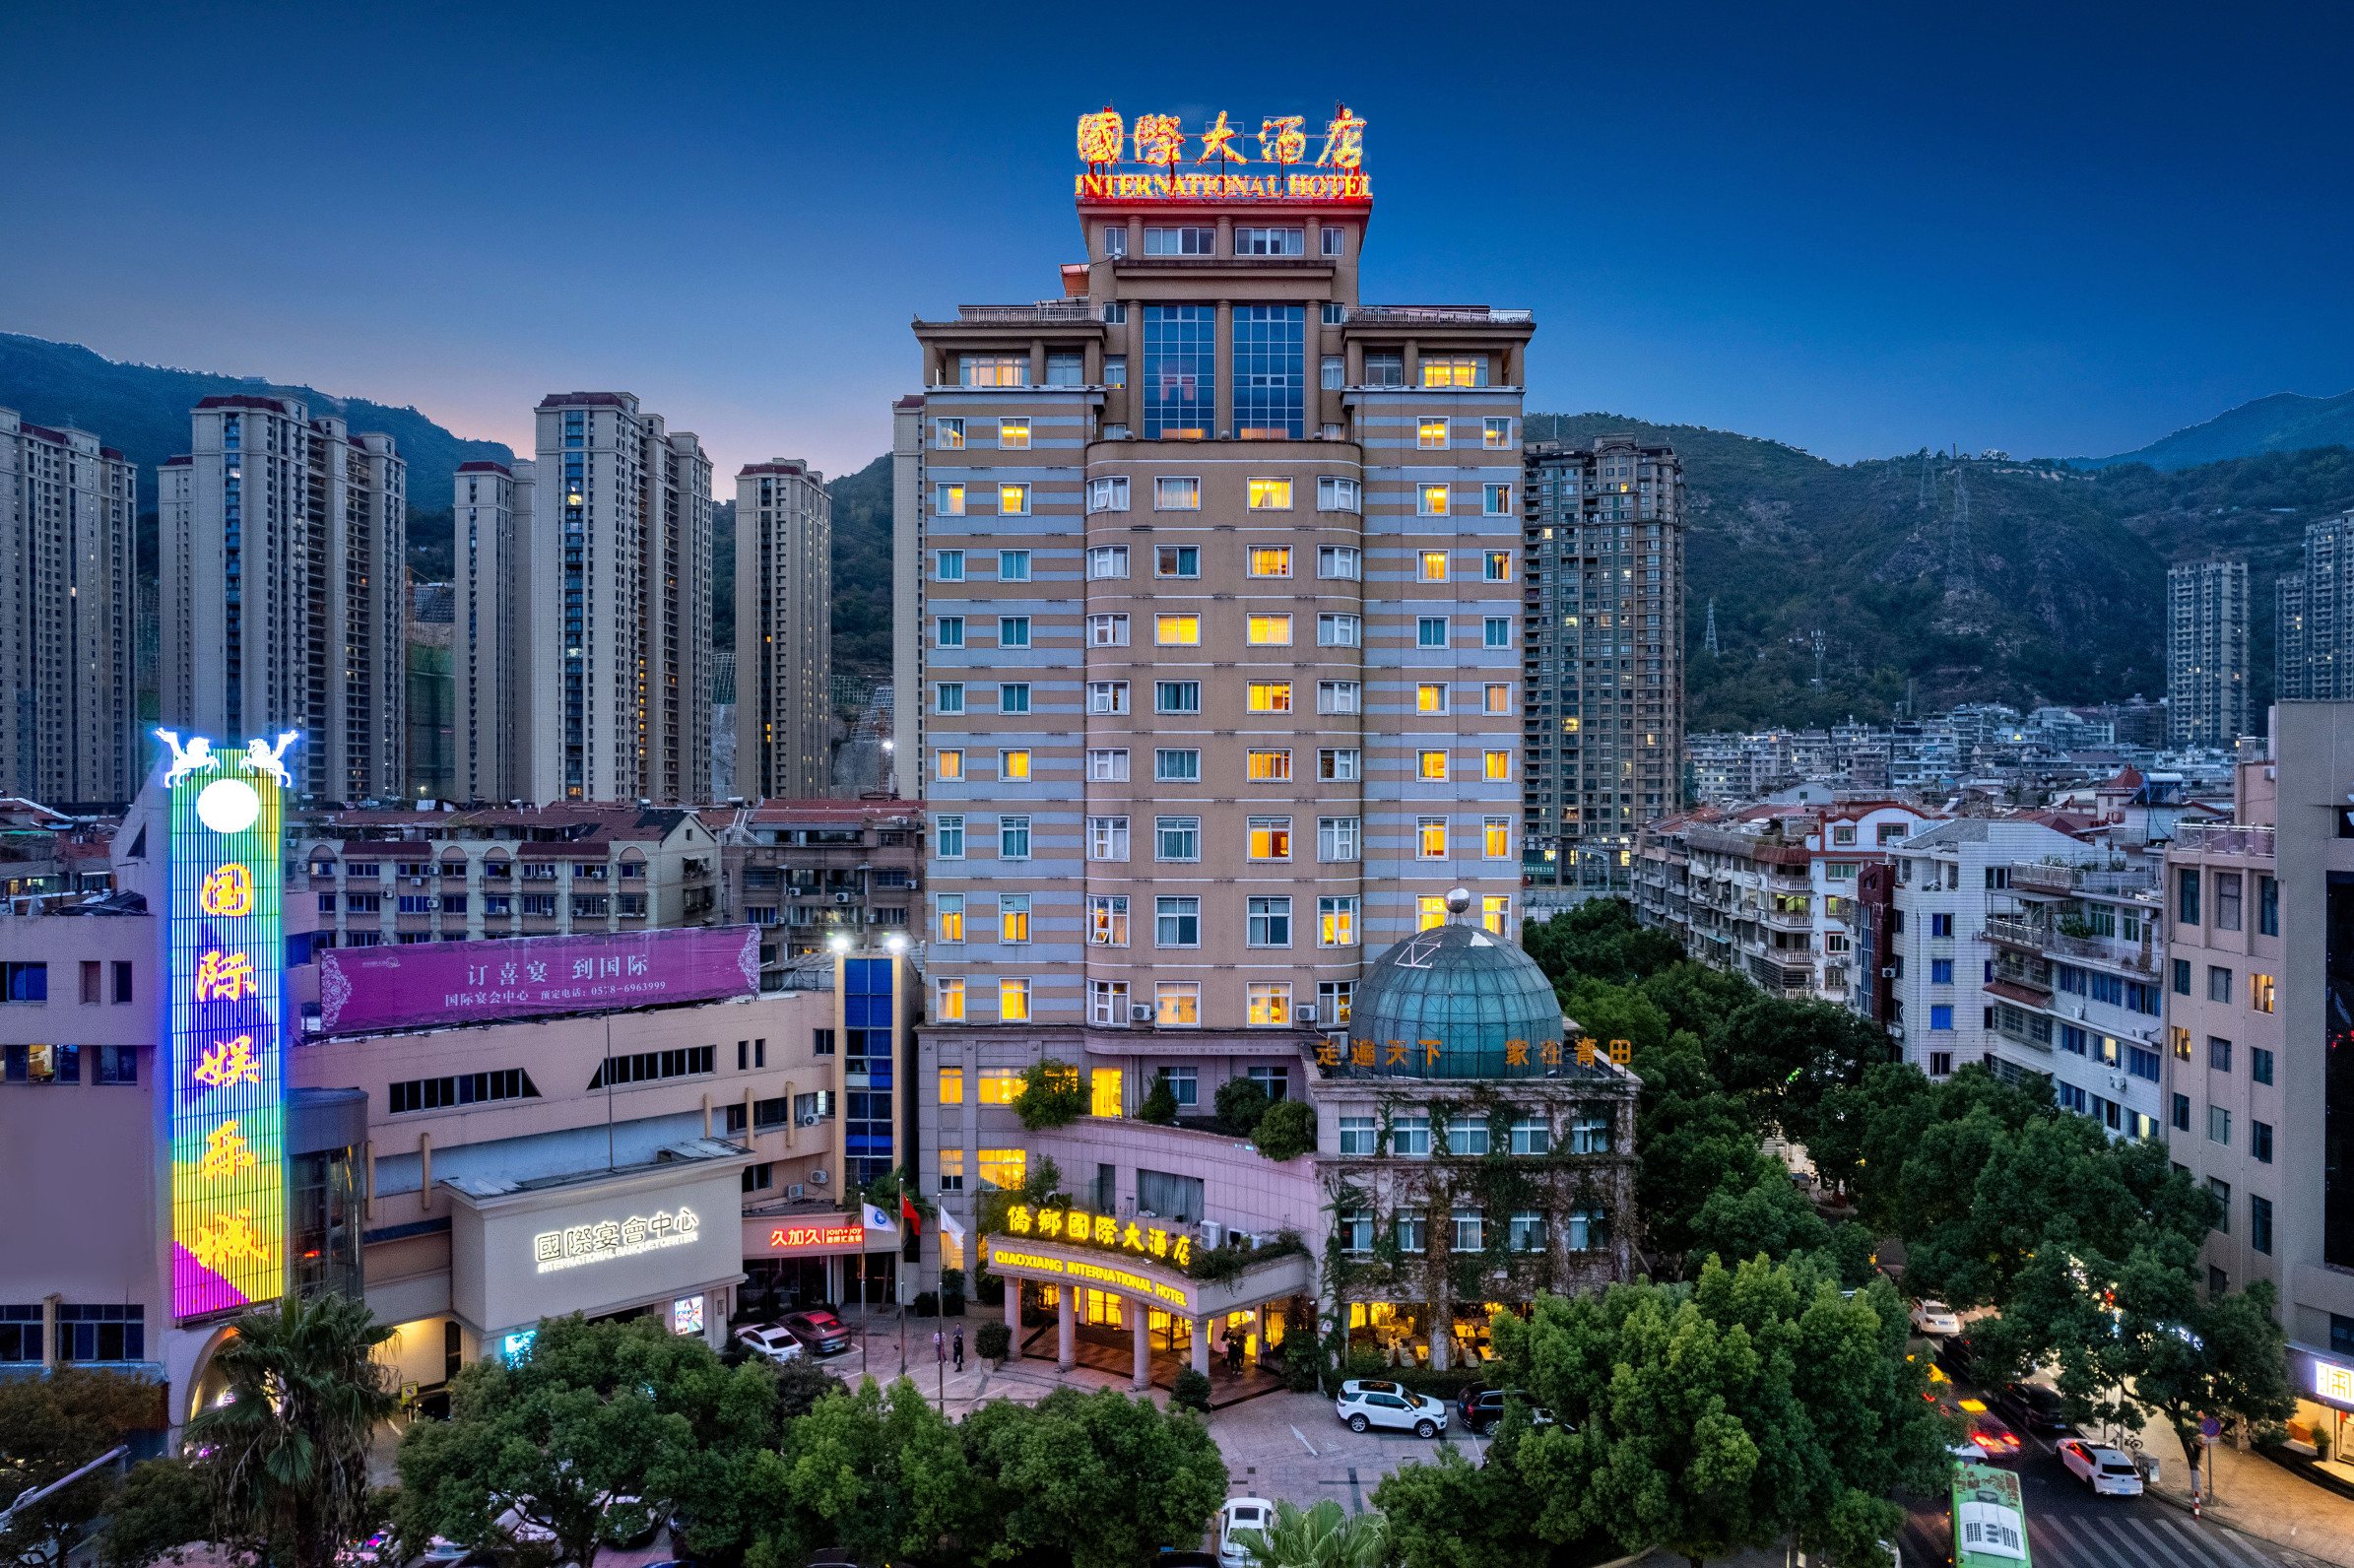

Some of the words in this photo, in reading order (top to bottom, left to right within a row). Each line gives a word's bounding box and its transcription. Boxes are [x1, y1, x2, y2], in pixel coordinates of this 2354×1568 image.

[1078, 108, 1367, 167] 國際大酒店
[1075, 174, 1283, 198] INTERNATIONAL
[1290, 174, 1373, 198] HOTEL
[468, 960, 549, 986] 订喜宴
[571, 953, 649, 981] 到国际
[444, 989, 529, 1008] 国际宴会中心
[194, 863, 270, 1267] 国际娱乐城
[1317, 1038, 1442, 1067] 走遍天下
[1505, 1036, 1631, 1067] 家在青田
[536, 1208, 698, 1262] 國際宴會中心
[771, 1229, 820, 1247] 久加久
[538, 1249, 616, 1274] INTERNATIONAL
[994, 1250, 1063, 1273] QIAOXIANG
[1067, 1261, 1152, 1293] INTERNATIONAL
[1155, 1282, 1188, 1306] HOTEL
